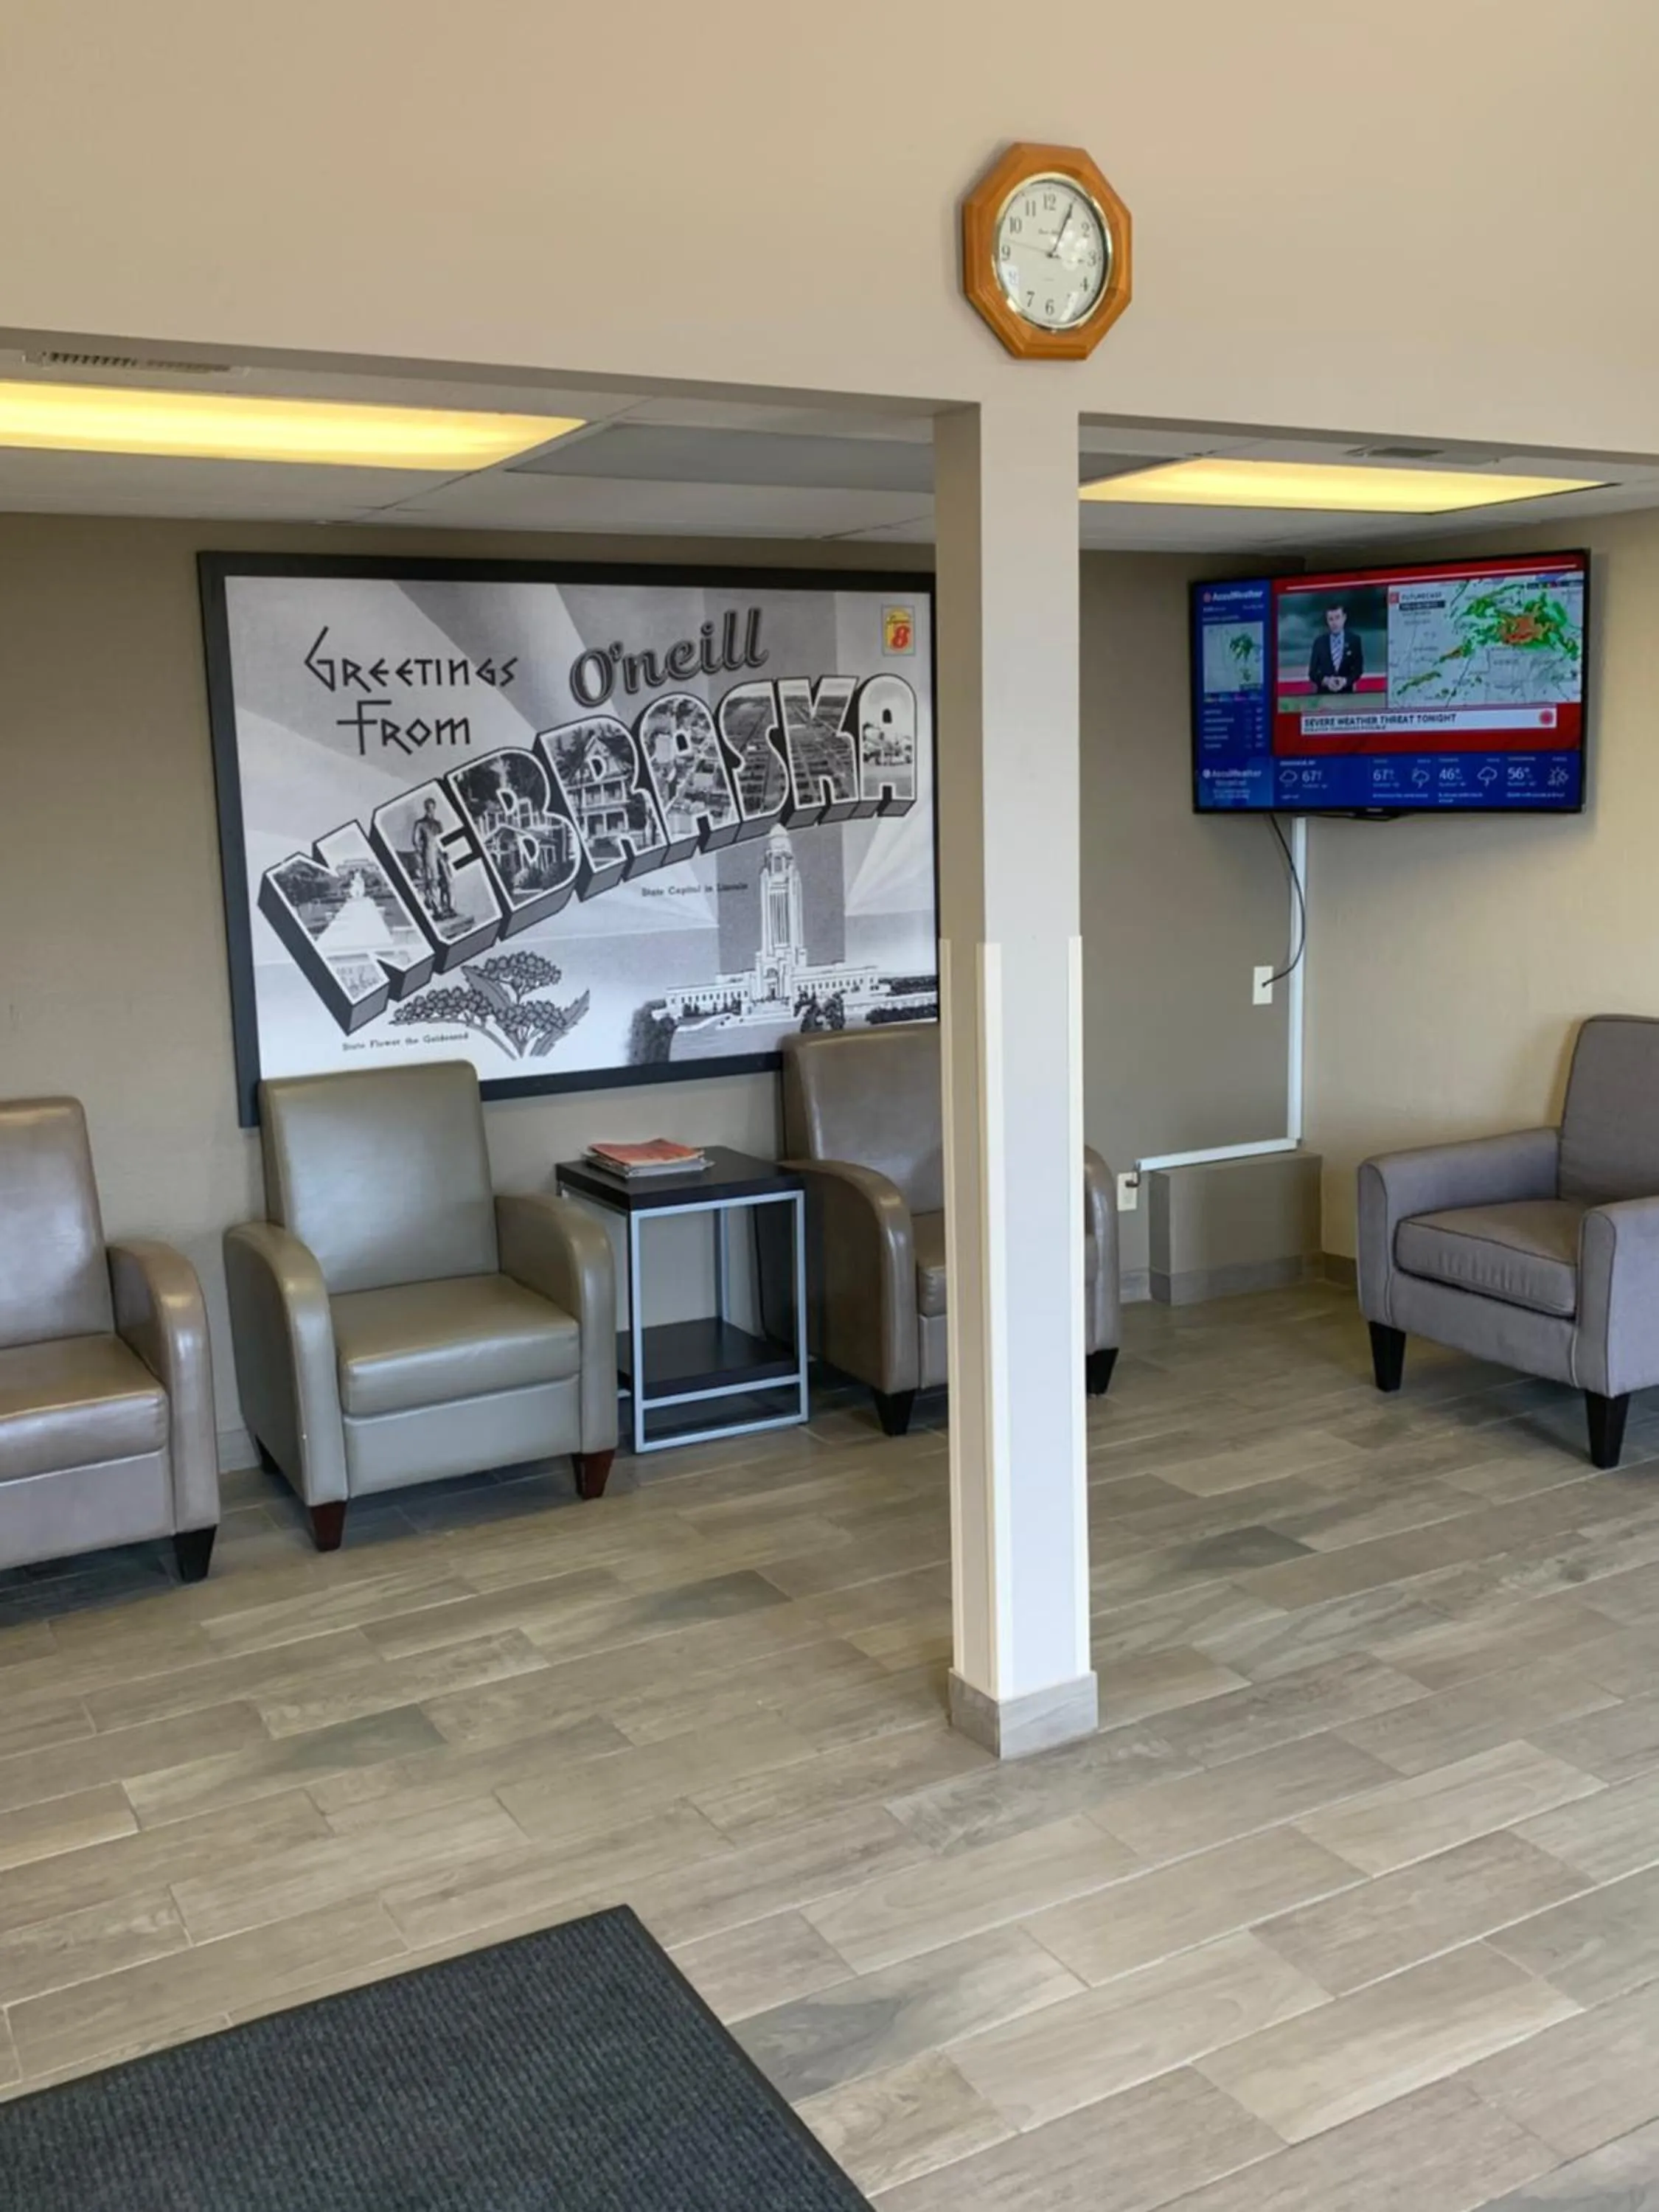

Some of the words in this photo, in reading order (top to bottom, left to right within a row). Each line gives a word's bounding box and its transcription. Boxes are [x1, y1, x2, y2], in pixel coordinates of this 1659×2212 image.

[1026, 200, 1037, 217] 11
[1043, 193, 1057, 211] 12
[1010, 216, 1023, 234] 10
[1081, 223, 1091, 237] 2
[1001, 245, 1011, 261] 9
[1087, 250, 1096, 267] 3
[1026, 291, 1035, 307] 7
[1045, 299, 1054, 316] 6
[1304, 717, 1335, 727] SEVERE
[1338, 715, 1378, 726] WEATHER
[1380, 714, 1414, 724] THREAT
[1417, 713, 1457, 723] TONIGHT
[258, 673, 918, 1034] NEBRASKA
